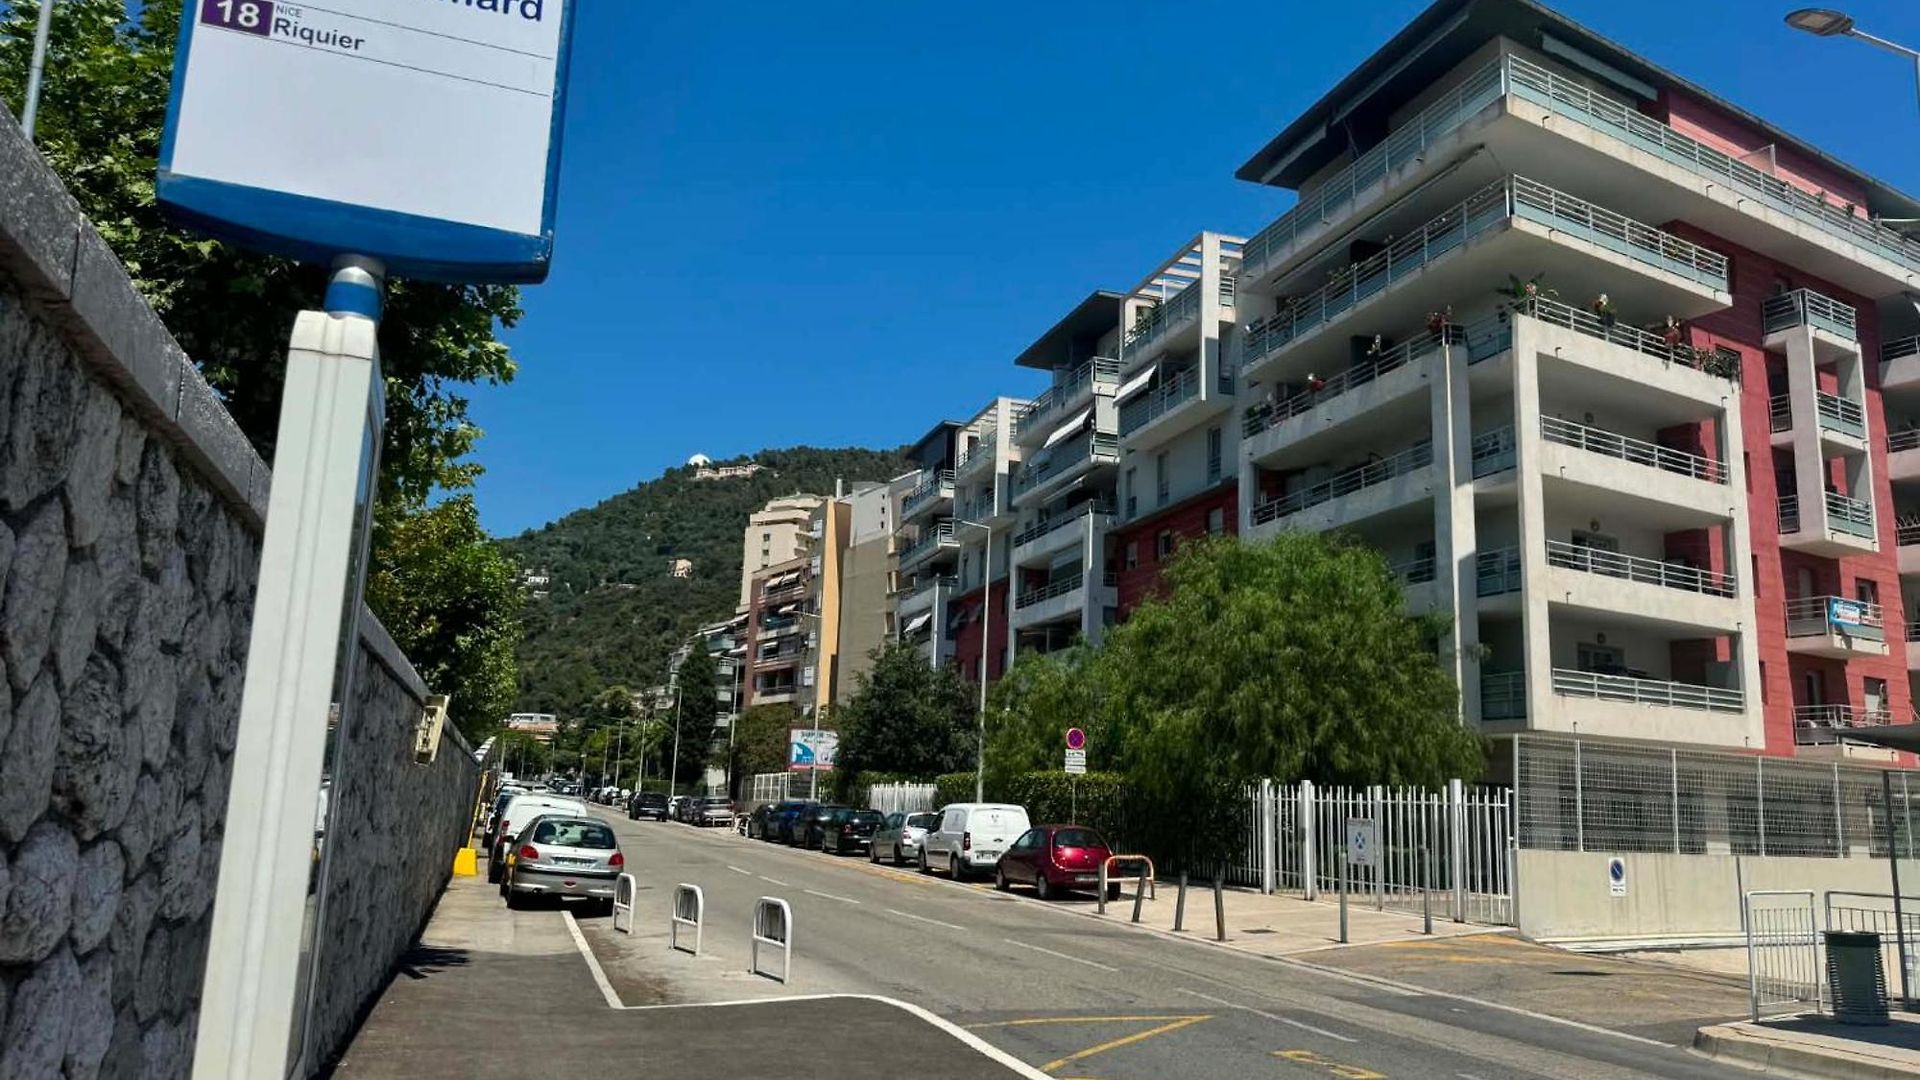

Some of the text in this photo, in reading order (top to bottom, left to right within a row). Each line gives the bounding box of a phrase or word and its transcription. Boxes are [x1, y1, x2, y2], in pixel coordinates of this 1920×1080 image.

[217, 0, 260, 27] 18
[275, 4, 303, 18] NICE
[273, 17, 366, 50] Riquier
